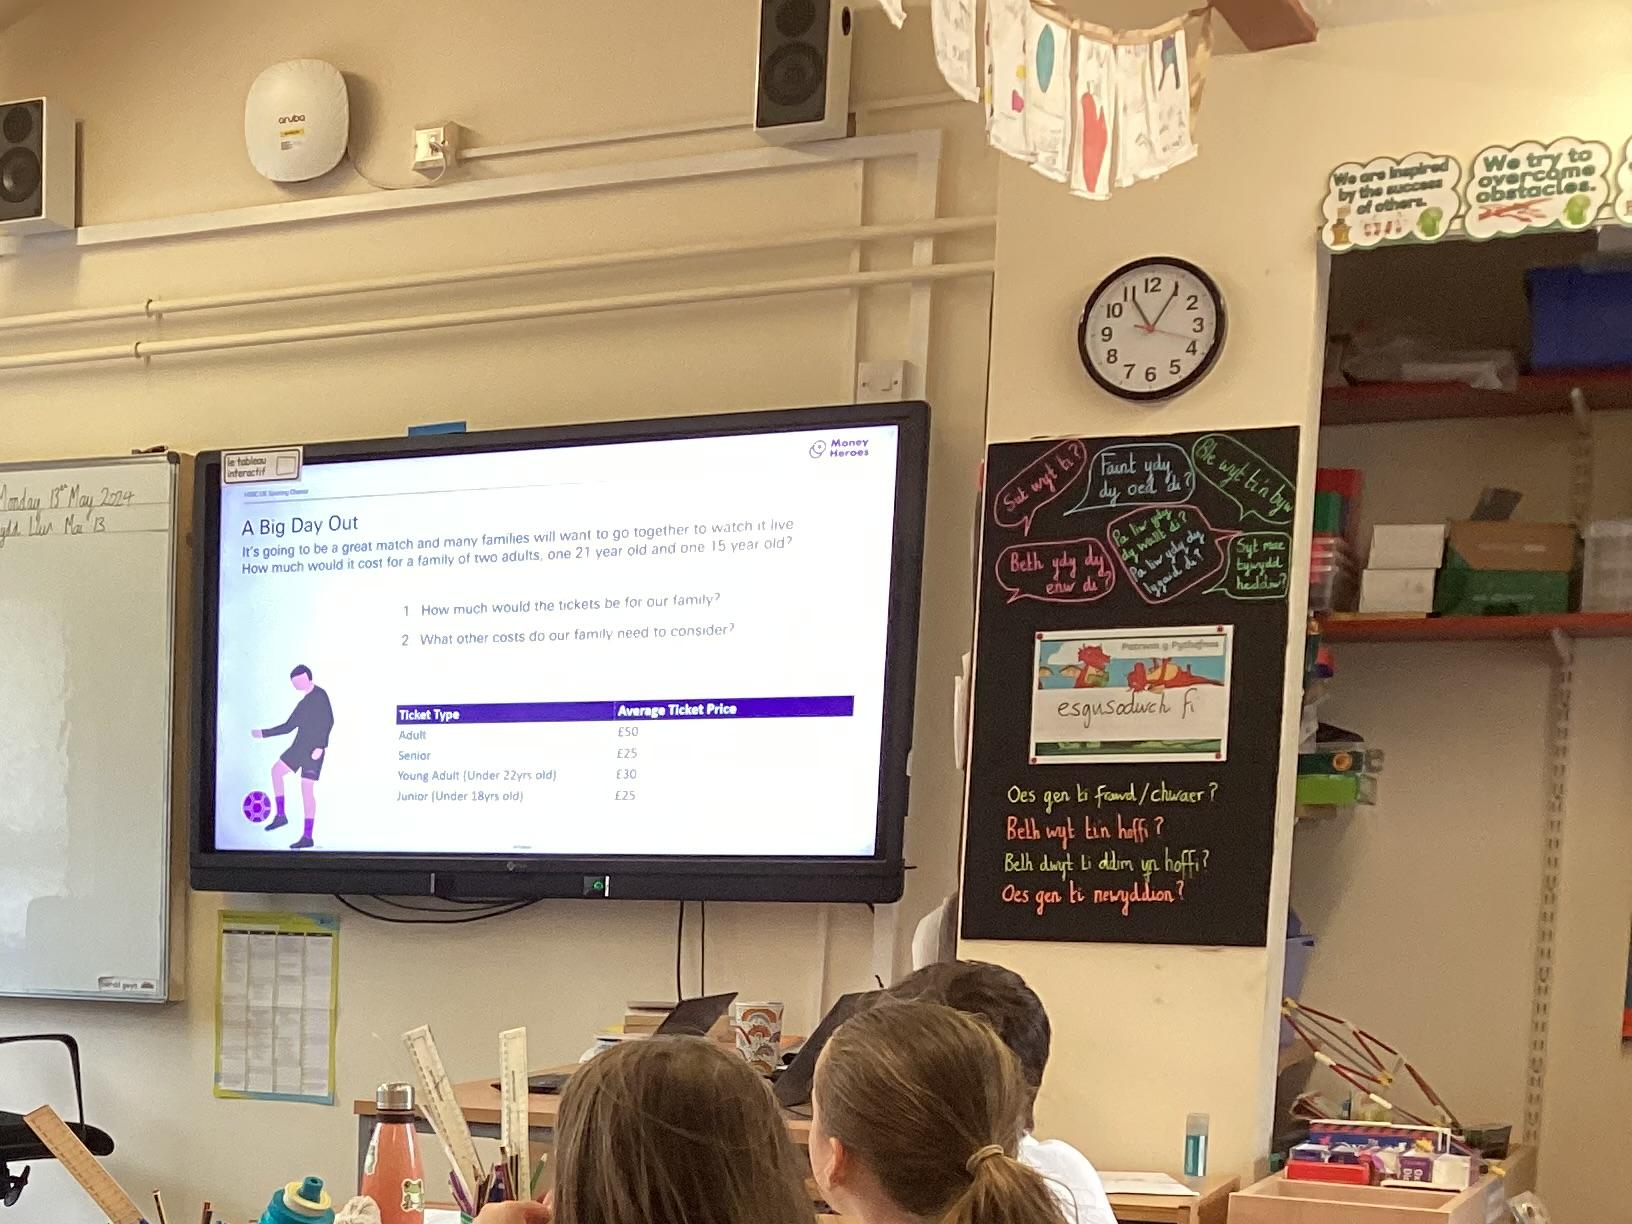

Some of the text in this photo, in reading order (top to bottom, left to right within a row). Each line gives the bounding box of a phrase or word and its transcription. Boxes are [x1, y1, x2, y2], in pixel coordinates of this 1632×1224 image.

[279, 115, 305, 124] aruba
[1483, 148, 1593, 172] We try to
[1333, 158, 1449, 187] We are inspired
[1478, 165, 1596, 188] overcome
[1338, 178, 1443, 204] by the success
[1476, 180, 1596, 203] obstacles.
[1356, 197, 1427, 215] of others.
[1144, 277, 1162, 293] 12
[1106, 303, 1123, 318] 10
[1186, 295, 1198, 310] 2
[1192, 317, 1204, 333] 3
[1101, 327, 1113, 342] 9
[1185, 340, 1197, 355] 4
[1106, 349, 1118, 364] 8
[1123, 364, 1136, 379] 7
[1145, 367, 1156, 382] 6
[1169, 359, 1181, 375] 5
[831, 438, 869, 447] Money
[830, 449, 869, 457] Heroes
[227, 456, 266, 467] le tableau
[227, 467, 266, 478] interactif
[68, 484, 94, 520] May
[241, 514, 358, 538] A Big Day Out
[242, 518, 793, 559] It's going to be a great match and many families will want to go together to watch it live
[242, 536, 792, 574] How much would it cost for a family of two adults, one 21 year old and one 15 year old?
[1010, 544, 1105, 581] Beth ydy dy
[404, 593, 720, 616] 1 How much would the tickets be for our family?
[402, 622, 734, 646] 2 What other costs do our family need to consider?
[399, 709, 460, 723] Ticket Type
[618, 703, 737, 719] Average Ticket Price
[1057, 688, 1198, 728] esgusodwch fi
[398, 730, 426, 740] Adult
[618, 726, 638, 737] £50
[398, 750, 430, 760] Senior
[616, 747, 637, 759] £25
[398, 769, 556, 783] Young Adult (Under 22yrs old)
[616, 768, 636, 780] £30
[396, 790, 523, 802] Junior (Under 18yrs old)
[614, 790, 635, 801] £25
[1007, 785, 1035, 803] Oes
[1044, 790, 1071, 815] gen
[1077, 783, 1088, 802] ti
[1046, 817, 1075, 850] wyt
[1098, 850, 1134, 871] ddim
[1141, 856, 1160, 882] yn
[1002, 884, 1029, 902] Oes
[1035, 889, 1062, 916] gen
[1069, 880, 1085, 904] ti
